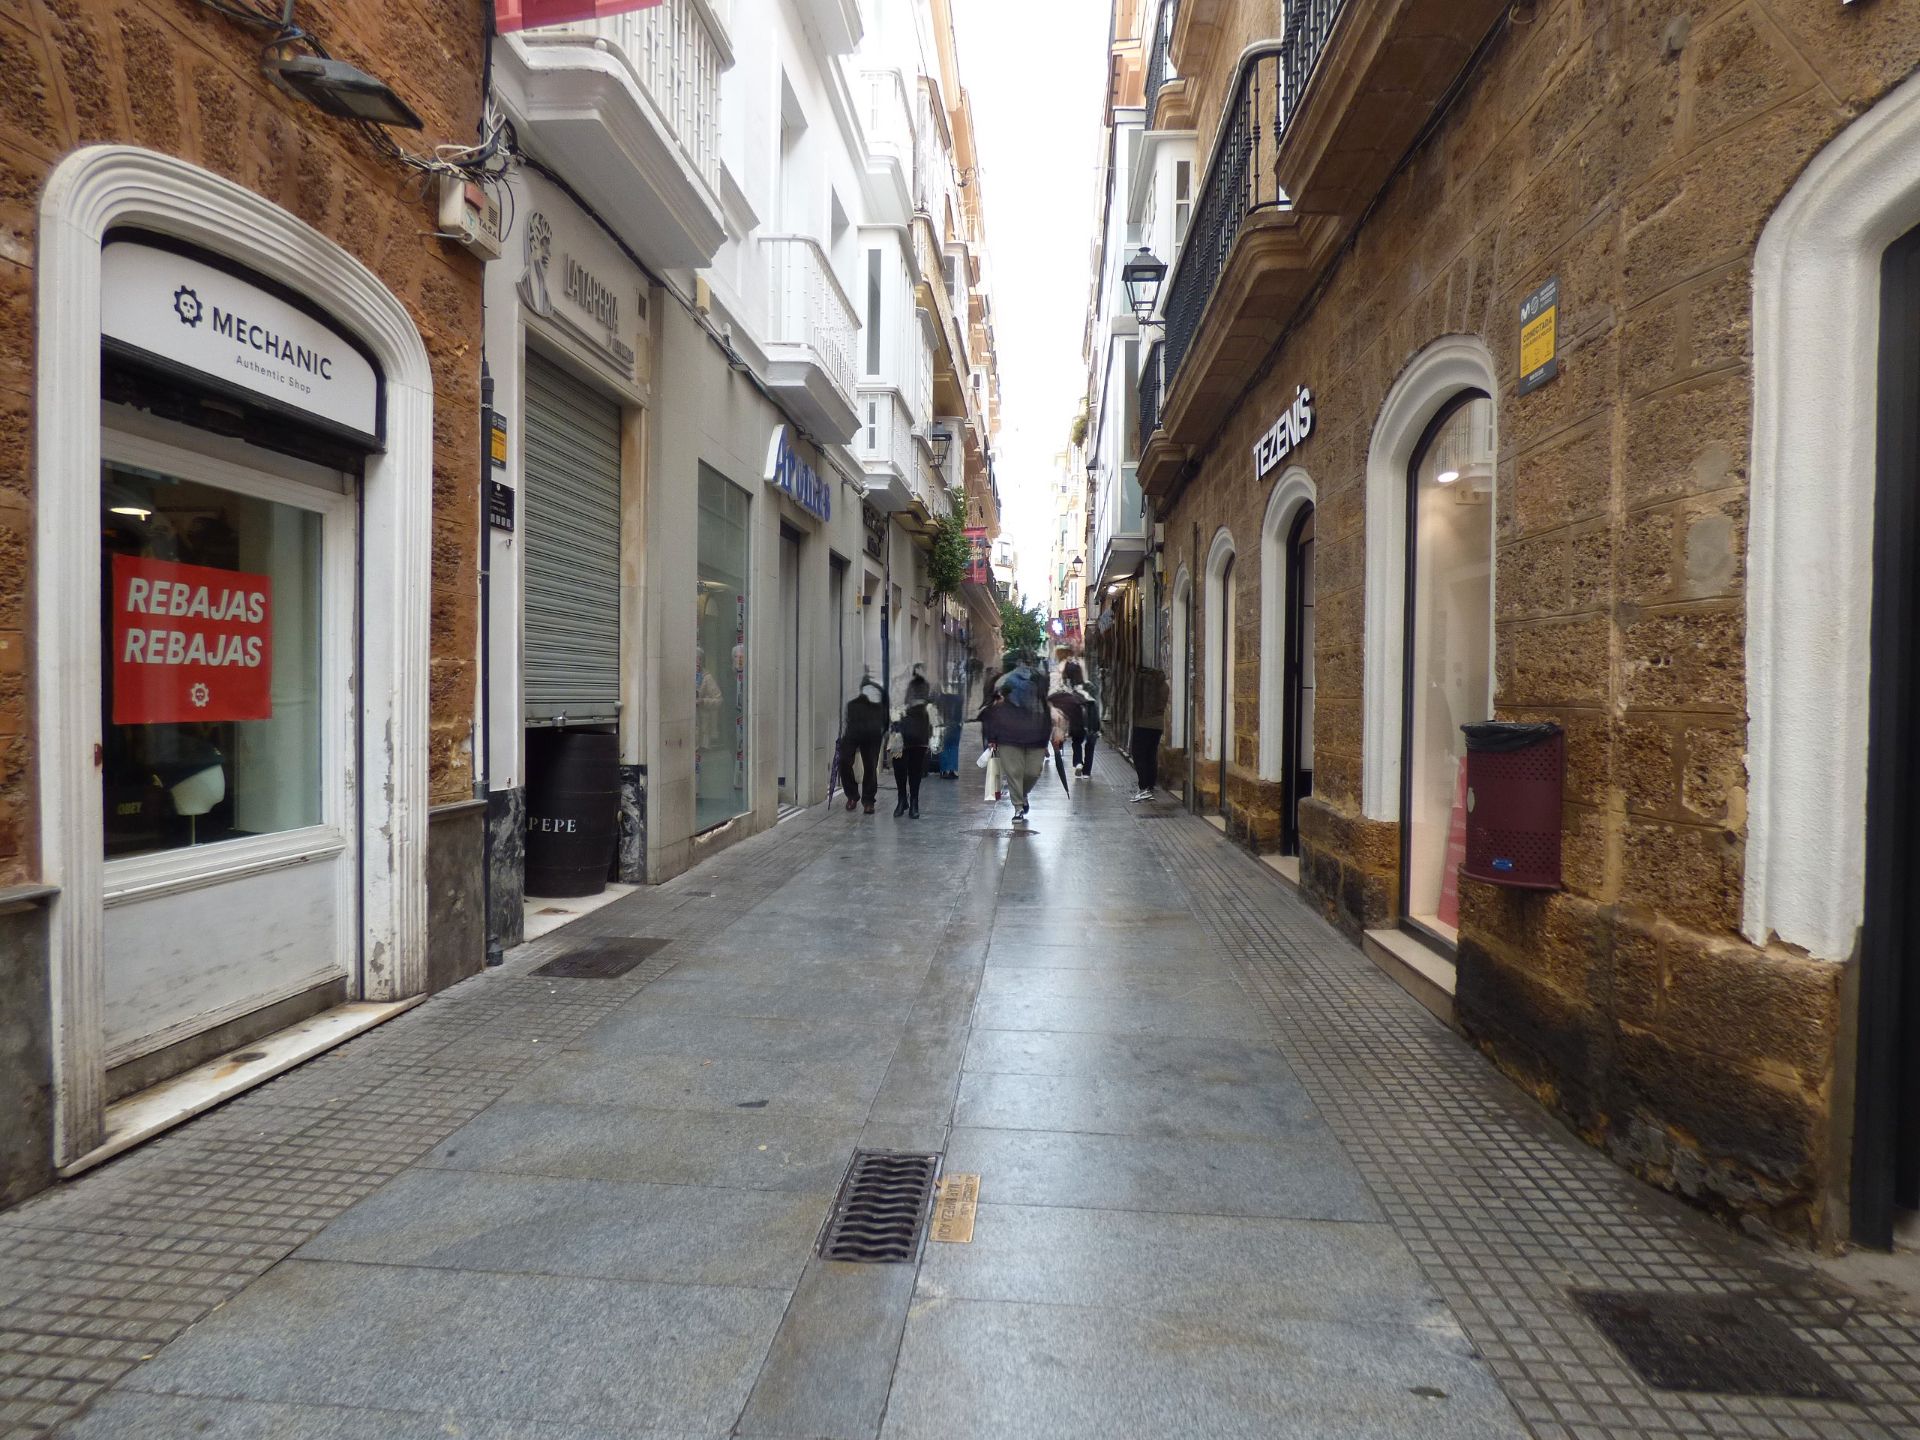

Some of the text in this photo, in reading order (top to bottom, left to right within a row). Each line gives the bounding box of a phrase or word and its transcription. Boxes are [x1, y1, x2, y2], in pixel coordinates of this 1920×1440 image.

[213, 306, 332, 380] MECHANIC
[236, 355, 311, 394] Authentic Shop
[1253, 385, 1311, 481] TEZENIS
[772, 424, 831, 522] Aromas
[126, 577, 265, 623] REBAJAS
[123, 628, 262, 667] REBAJAS
[528, 816, 577, 833] PEPE
